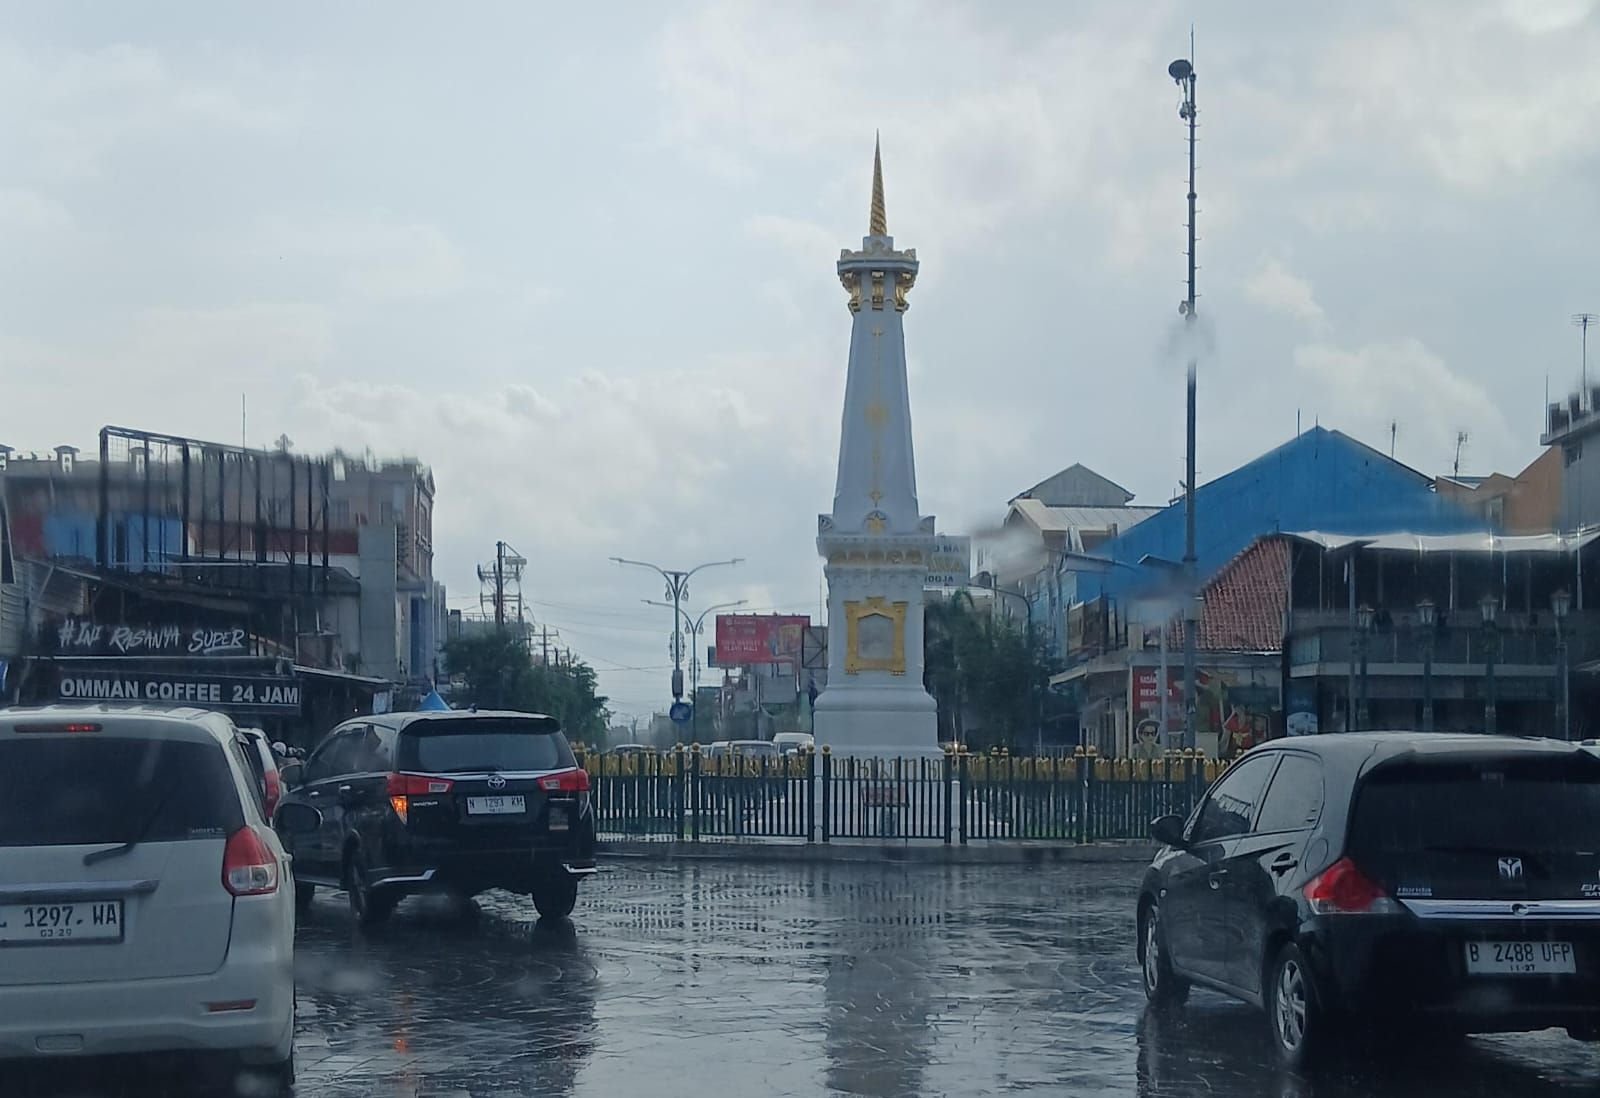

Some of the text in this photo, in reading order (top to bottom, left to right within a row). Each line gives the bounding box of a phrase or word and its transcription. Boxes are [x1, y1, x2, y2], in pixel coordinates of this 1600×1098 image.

[109, 624, 180, 653] RASANYA
[188, 628, 245, 653] SUPER
[60, 677, 298, 703] OMMAN COFFEE 24 JAM
[92, 903, 117, 925] WA
[1469, 943, 1570, 962] B 2488 UFP
